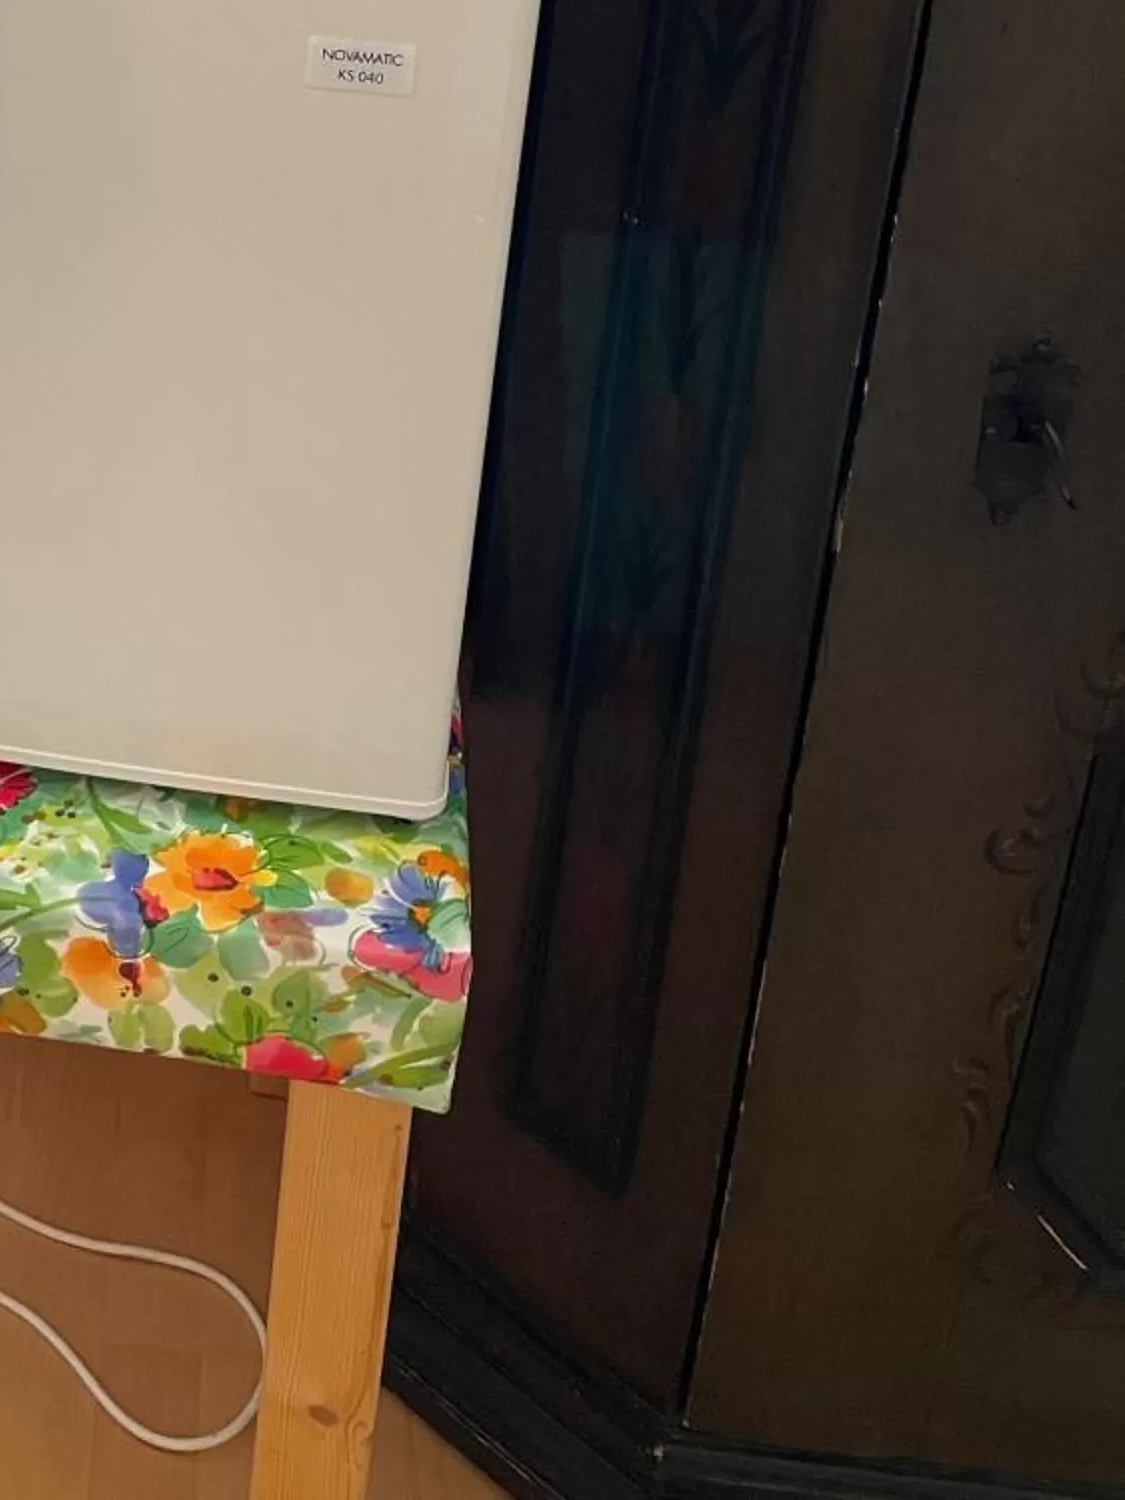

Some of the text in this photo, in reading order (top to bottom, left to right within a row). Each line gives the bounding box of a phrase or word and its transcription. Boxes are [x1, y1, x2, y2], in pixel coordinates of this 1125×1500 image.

[322, 47, 404, 67] NOVAMATIC
[337, 68, 384, 85] KS 040
